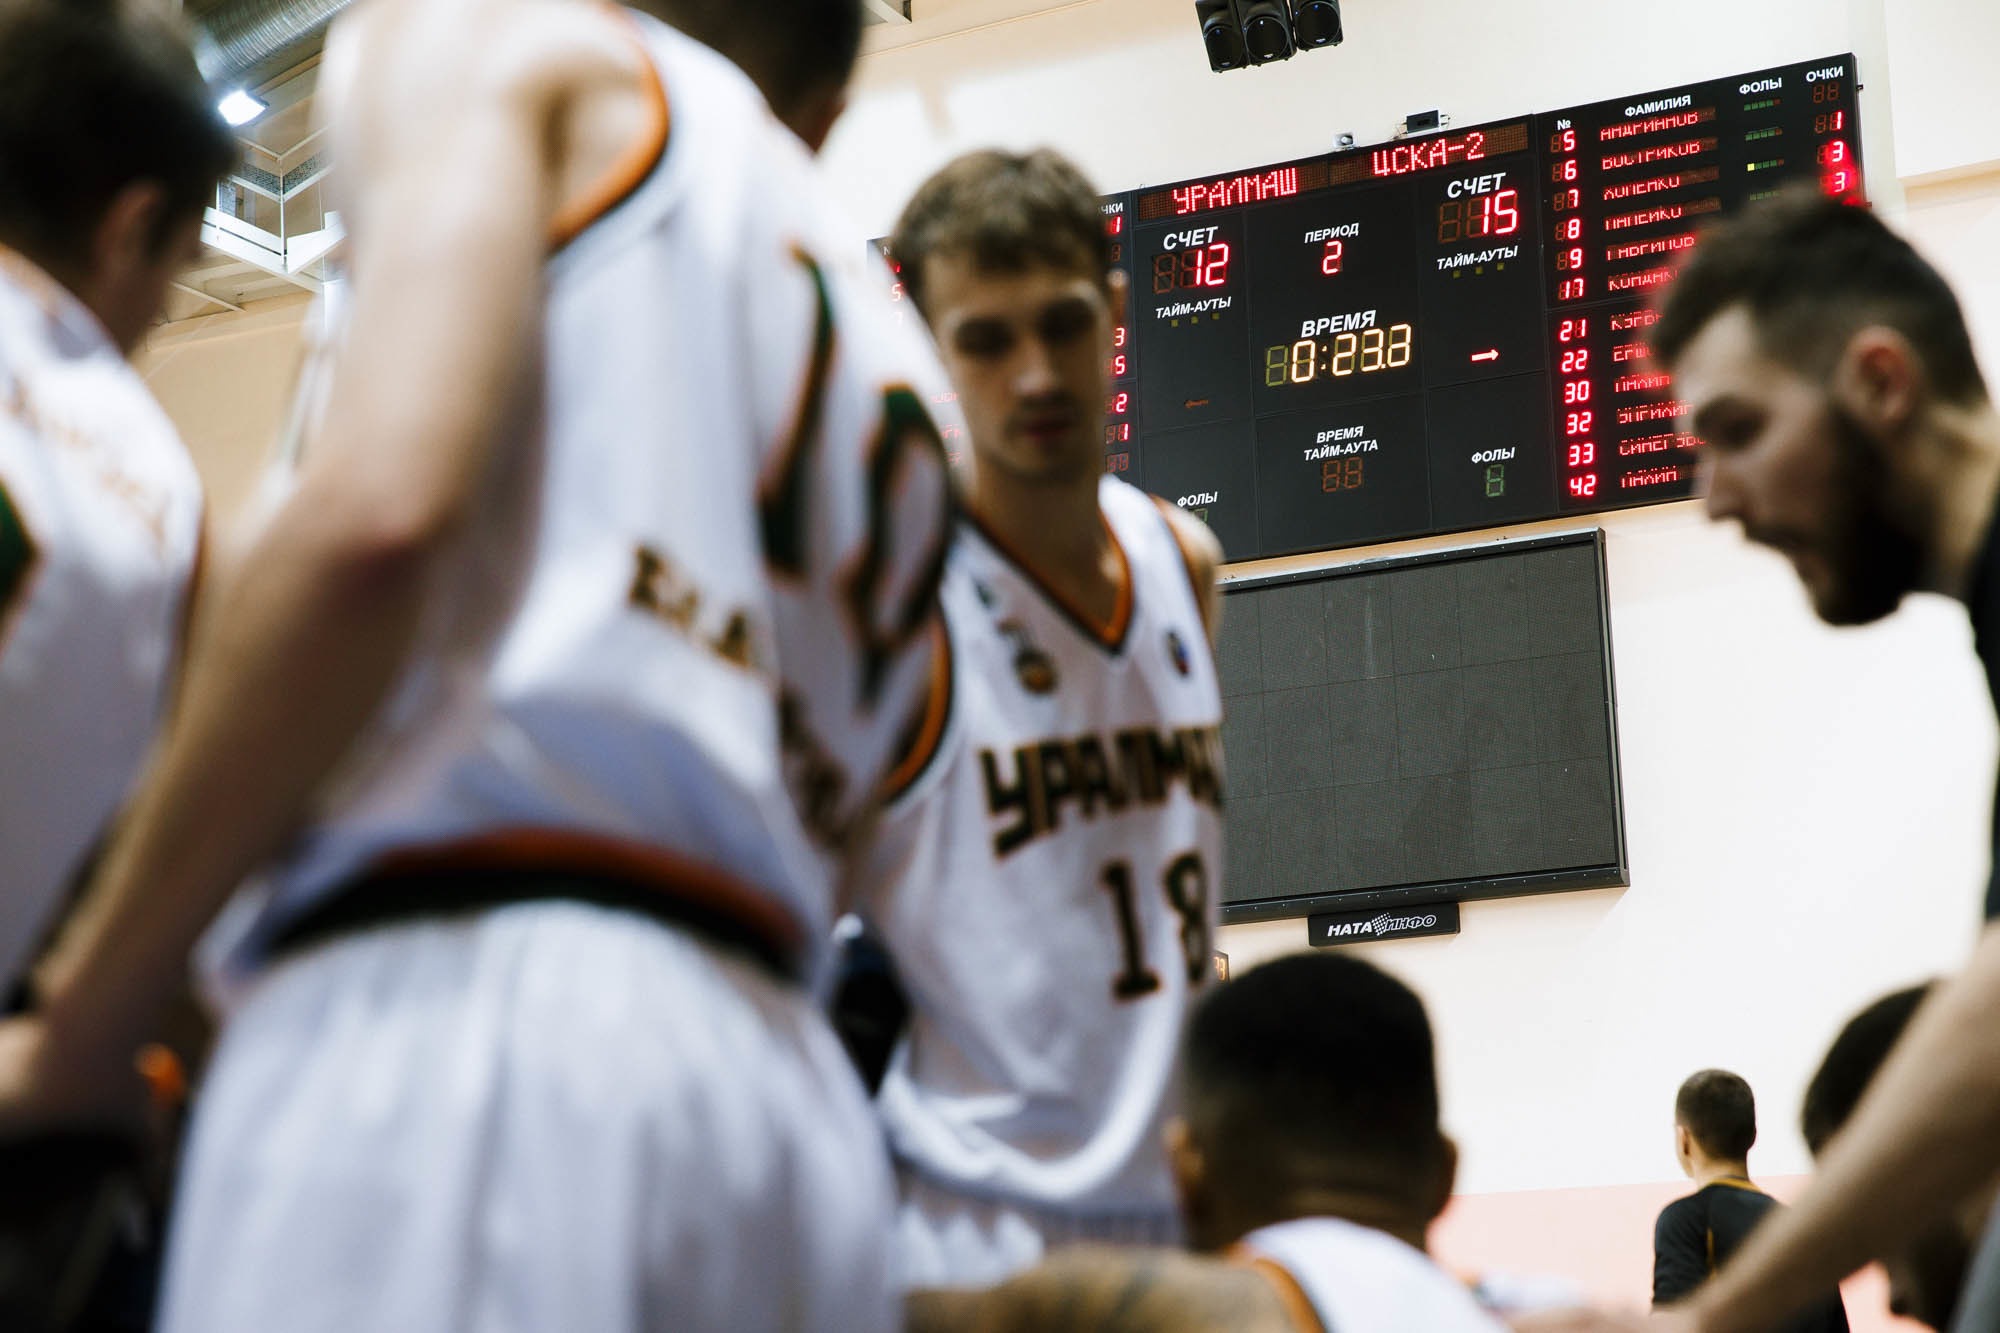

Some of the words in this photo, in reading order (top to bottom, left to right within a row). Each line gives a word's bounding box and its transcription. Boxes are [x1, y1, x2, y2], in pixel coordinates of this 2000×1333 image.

[1806, 66, 1843, 82] ОЧКИ
[1739, 78, 1782, 95] ФОЛЫ
[1625, 95, 1691, 117] ФАМИЛИЯ
[1557, 119, 1571, 130] №
[1563, 131, 1575, 151] 5
[1832, 141, 1844, 162] 3
[1373, 132, 1485, 177] ЦСКА-2
[1563, 160, 1576, 180] 6
[1173, 167, 1298, 215] УРАЛМАШ
[1447, 173, 1506, 198] СЧЕТ
[1834, 171, 1846, 192] 3
[1099, 203, 1123, 215] ЧКИ
[1568, 188, 1579, 208] 7
[1481, 190, 1518, 234] 15
[1163, 226, 1218, 251] СЧЕТ
[1304, 223, 1360, 243] ПЕРИОД
[1567, 218, 1580, 239] 8
[1195, 243, 1229, 286] 12
[1322, 241, 1342, 275] 2
[1437, 246, 1518, 271] ТАЙМ-АУТЫ
[1569, 248, 1582, 269] 9
[1565, 278, 1583, 299] 17
[1155, 297, 1231, 319] ТАЙМ-АУТЫ
[1301, 310, 1376, 338] ВРЕМЯ
[1560, 319, 1586, 342] 21
[1114, 327, 1125, 347] 3
[1114, 355, 1126, 375] 5
[1561, 350, 1588, 372] 22
[1115, 393, 1127, 412] 2
[1564, 381, 1590, 403] 30
[1567, 411, 1592, 434] 32
[1316, 426, 1364, 444] ВРЕМЯ
[1303, 439, 1379, 461] ТАЙМ-АУТА
[1471, 446, 1515, 464] ФОЛЫ
[1568, 443, 1594, 466] 33
[1570, 474, 1596, 496] 42
[1177, 491, 1218, 508] ФОЛЫ
[1102, 851, 1212, 997] 18
[1327, 920, 1373, 937] НАТА
[1384, 914, 1437, 933] ИНФО
